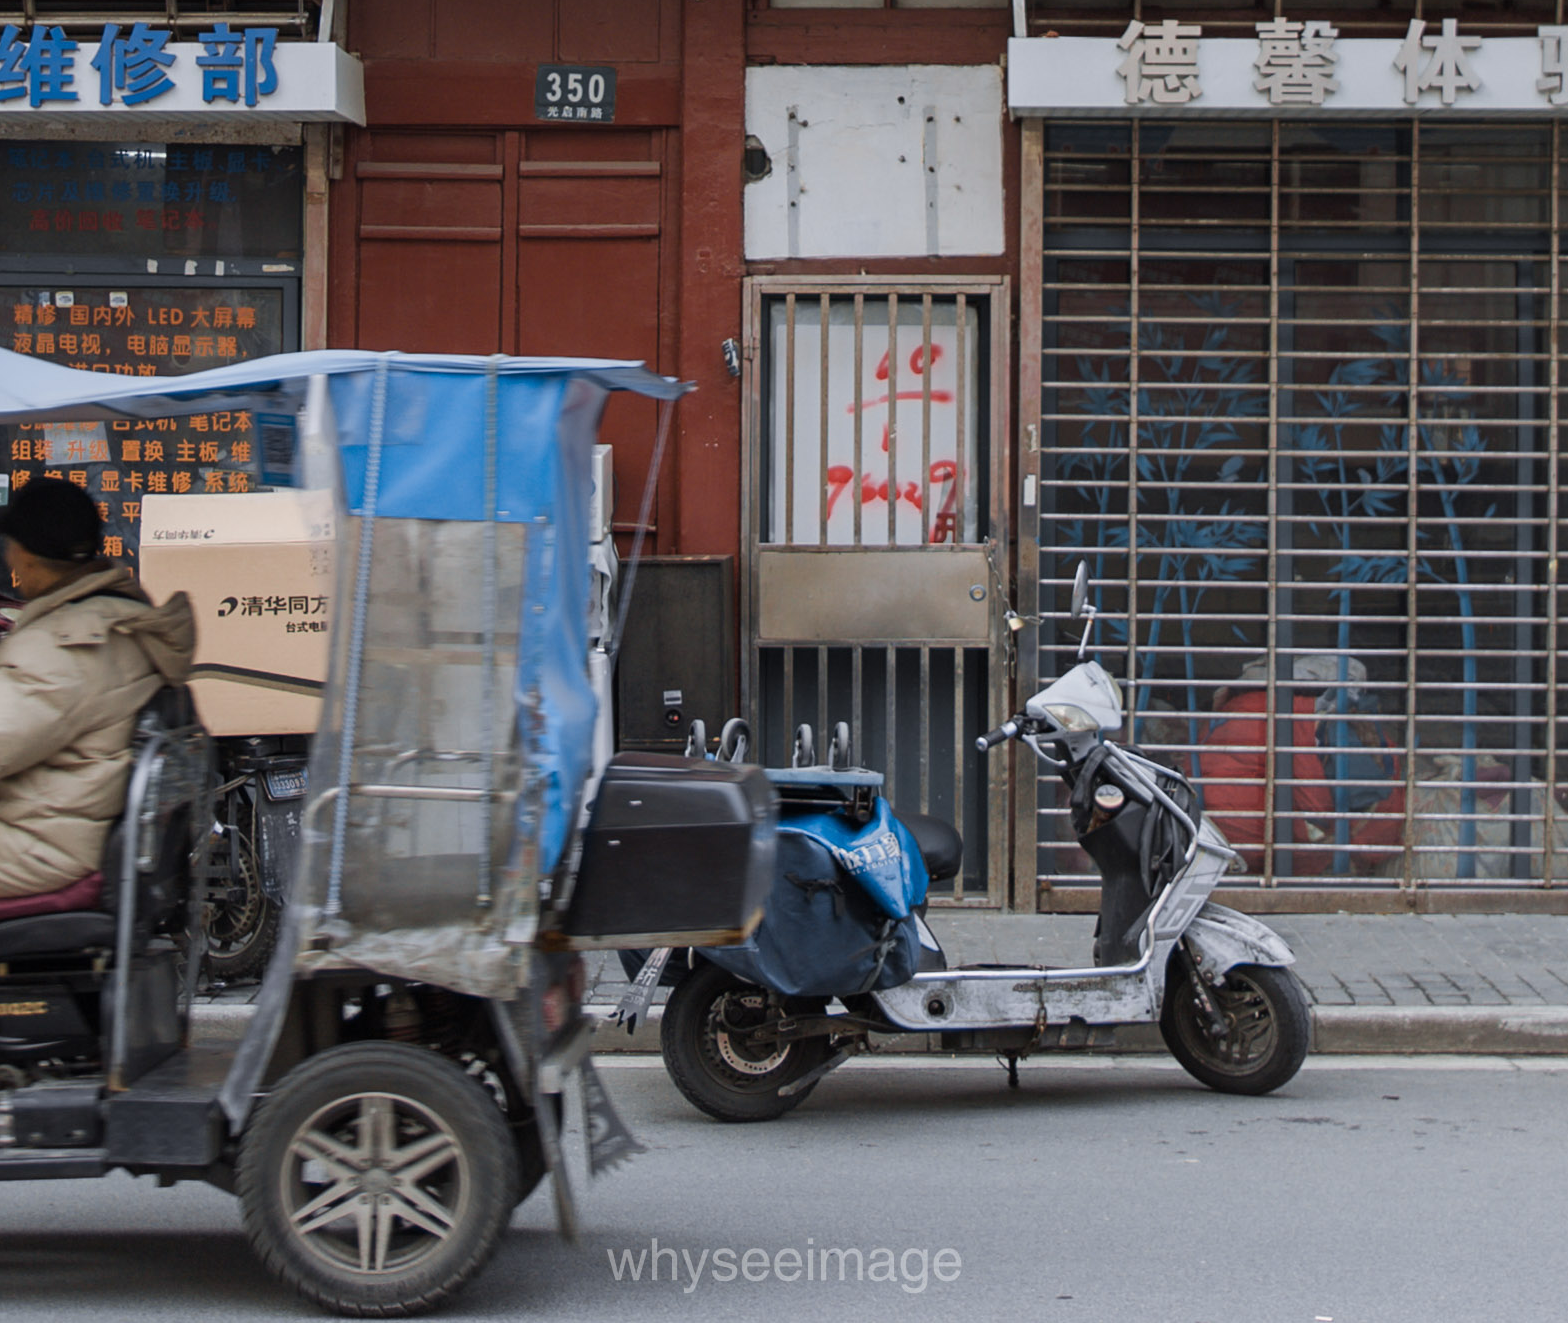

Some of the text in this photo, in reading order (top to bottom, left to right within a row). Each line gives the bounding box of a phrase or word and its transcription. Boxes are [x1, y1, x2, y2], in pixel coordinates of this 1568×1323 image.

[546, 73, 605, 103] 350
[547, 105, 603, 120] 光启南路
[29, 209, 124, 232] 高价回收
[13, 304, 257, 329] 精修 国内外 LED 大屏幕
[12, 439, 252, 463] 组装 升级 置换 主板 维
[101, 470, 191, 493] 显卡维修
[205, 470, 249, 493] 系统
[241, 595, 329, 617] 清华同方
